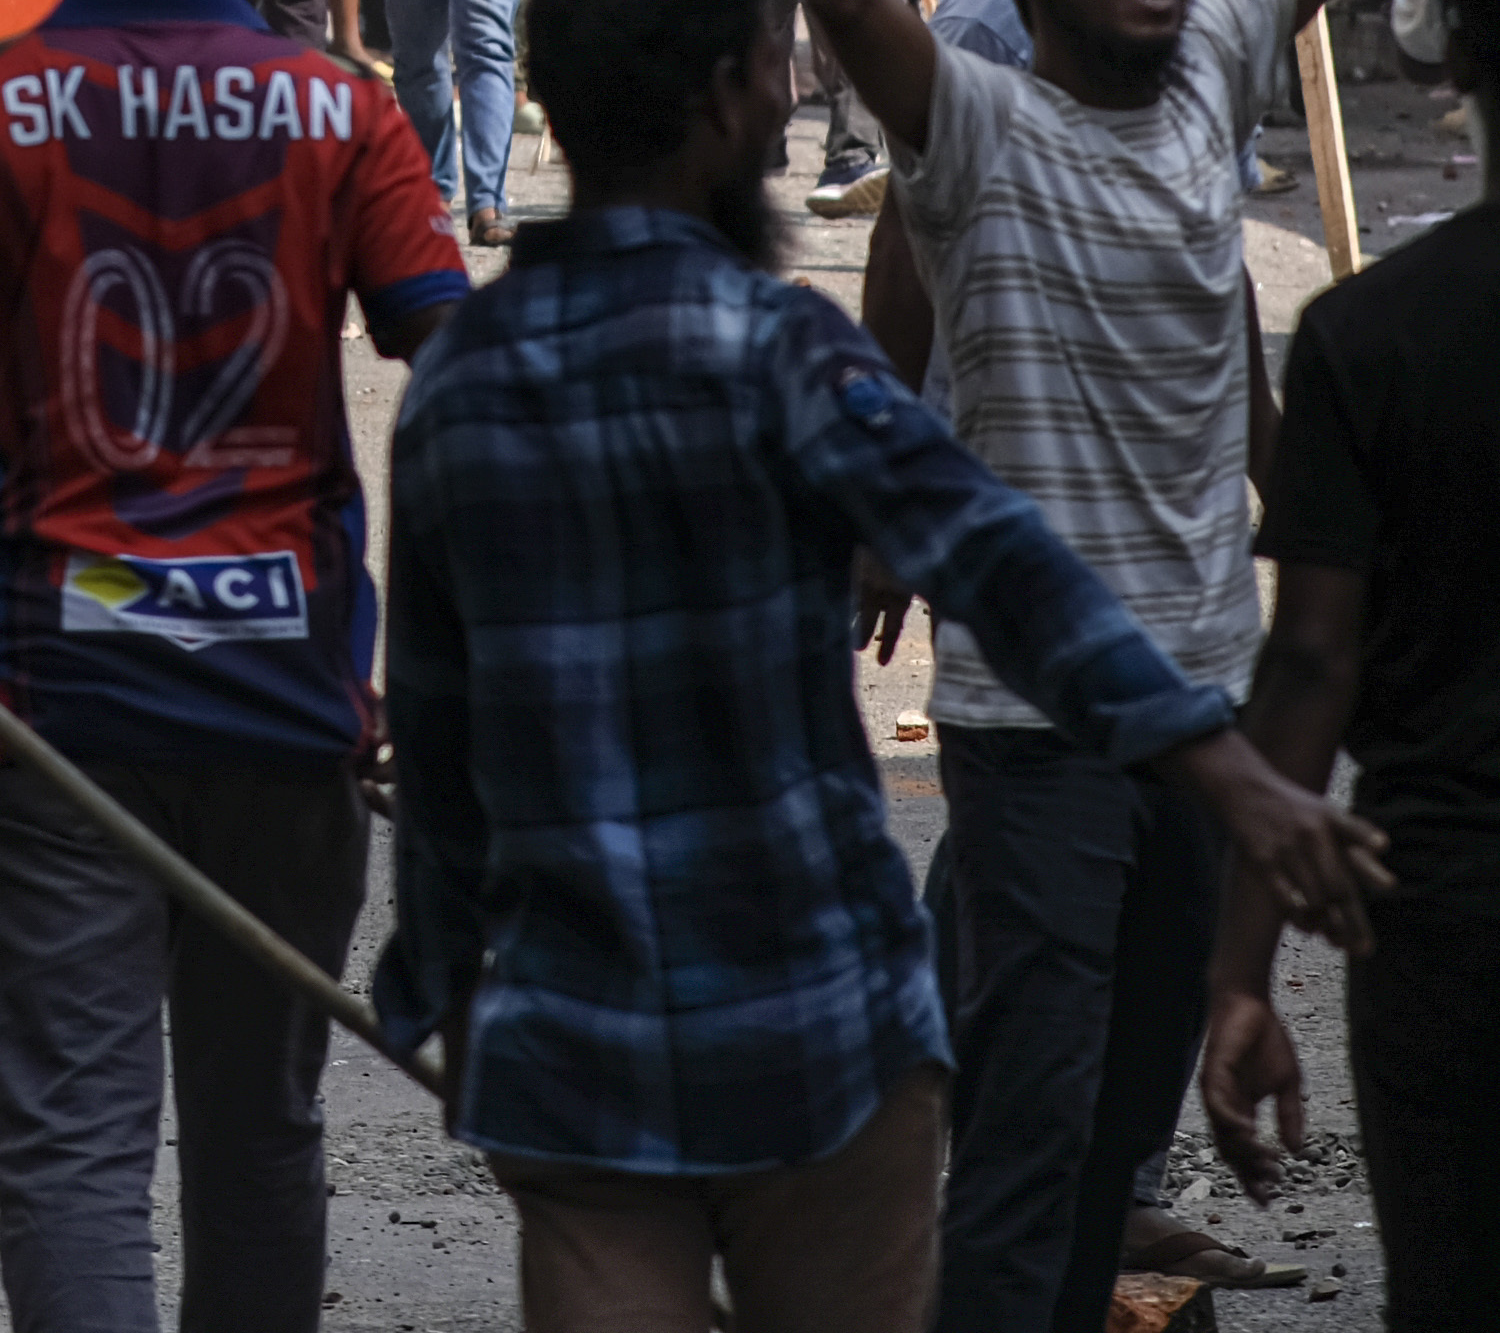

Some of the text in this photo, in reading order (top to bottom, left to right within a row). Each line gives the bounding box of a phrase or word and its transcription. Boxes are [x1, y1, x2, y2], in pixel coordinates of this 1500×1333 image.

[1, 65, 353, 147] SK HASAN
[61, 240, 299, 472] 02
[158, 566, 290, 610] ACI
